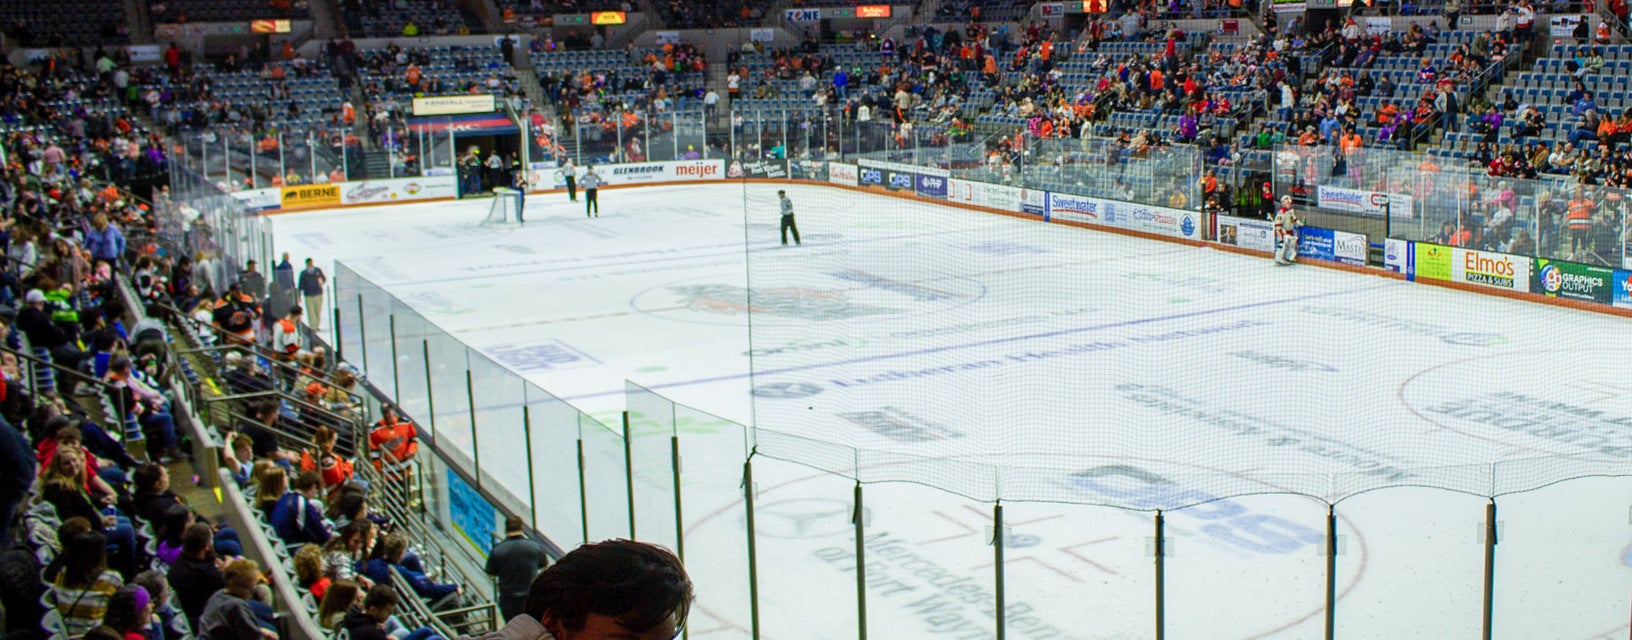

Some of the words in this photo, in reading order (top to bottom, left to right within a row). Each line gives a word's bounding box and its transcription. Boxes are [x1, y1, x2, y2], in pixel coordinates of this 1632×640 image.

[613, 164, 665, 176] GLENBROOK
[675, 161, 719, 178] meijer
[299, 186, 337, 199] BERNE
[1321, 187, 1363, 202] Sweetwater
[1052, 195, 1098, 214] Sweetwater
[1465, 251, 1514, 276] Elmo's
[1467, 272, 1487, 283] PIZZA
[1493, 277, 1513, 287] SUBS
[1562, 272, 1604, 287] GRAPHICS
[1563, 281, 1593, 294] OUTPUT
[848, 531, 1074, 640] Mercedes-Ben
